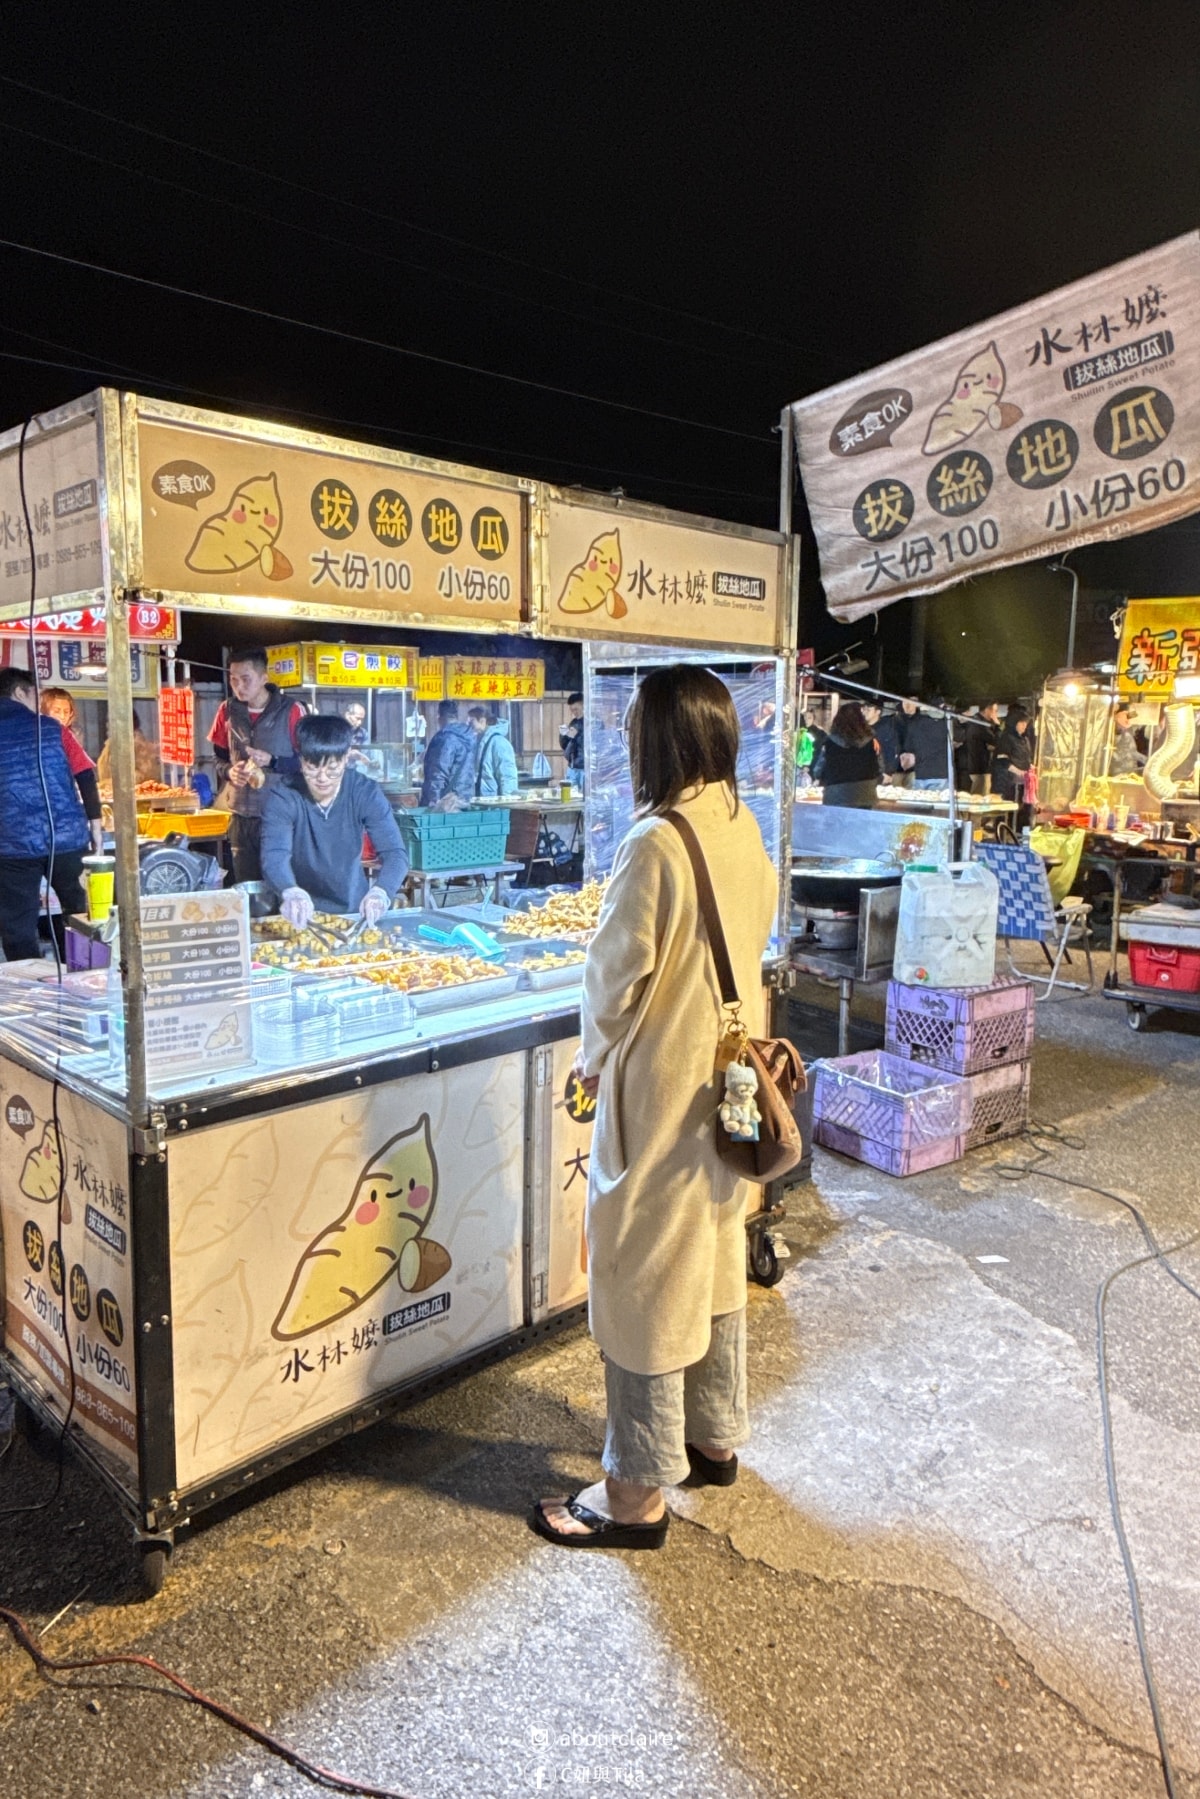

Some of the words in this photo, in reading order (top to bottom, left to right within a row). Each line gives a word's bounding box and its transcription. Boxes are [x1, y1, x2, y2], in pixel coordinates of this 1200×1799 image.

[1026, 285, 1167, 367] 水林嬤
[1075, 336, 1163, 387] 拔絲地瓜
[1107, 373, 1138, 389] Sweet
[1142, 360, 1175, 376] Potato
[836, 395, 907, 451] 素食OK
[158, 470, 212, 496] 素食OK
[862, 391, 1166, 538] 拔絲地瓜
[317, 486, 507, 555] 拔絲地瓜
[861, 519, 1000, 591] 大份100
[1045, 458, 1188, 532] 小份60
[311, 550, 411, 592] 大份100
[438, 566, 510, 601] 小份60
[627, 560, 708, 605] 水林嬤
[718, 575, 760, 598] 拔絲地瓜
[141, 612, 158, 624] B2
[24, 1277, 64, 1338] 大份100
[389, 1296, 445, 1331] 拔絲地瓜
[76, 1334, 130, 1392] 小份60
[280, 1319, 380, 1384] 水林嬤
[75, 1386, 135, 1440] 988-865-109
